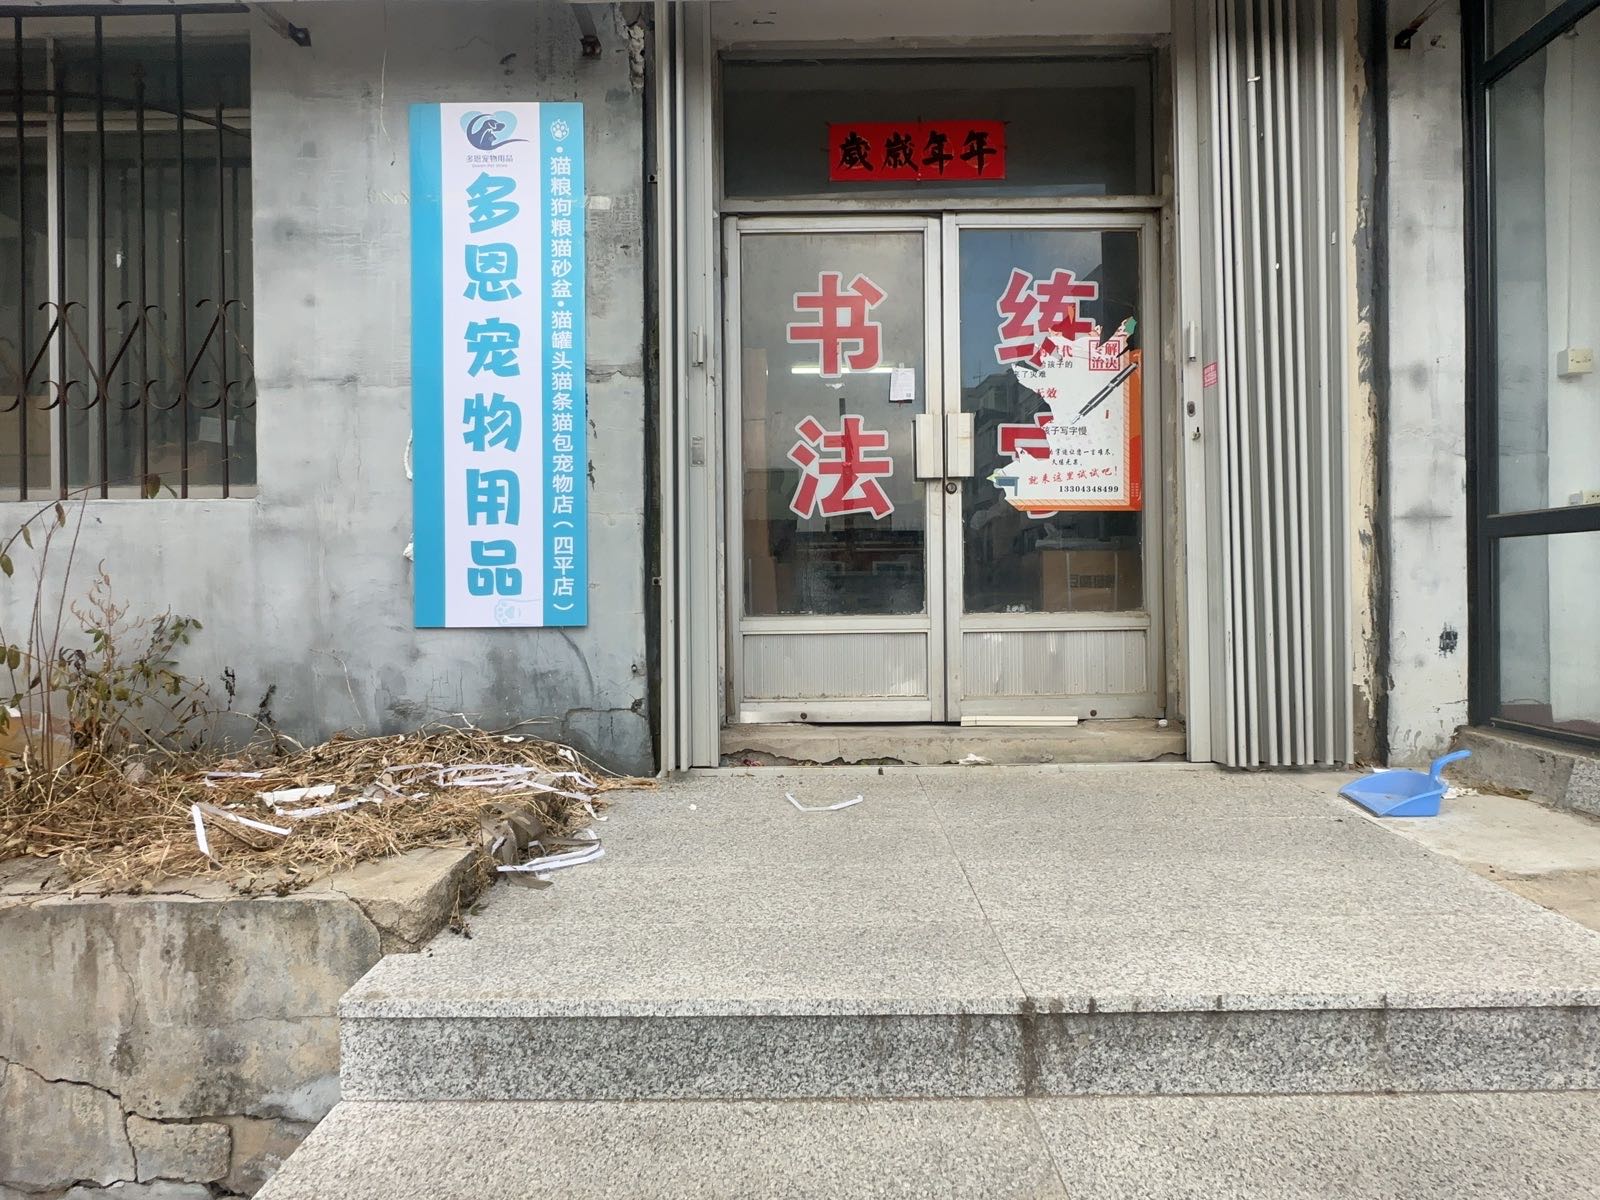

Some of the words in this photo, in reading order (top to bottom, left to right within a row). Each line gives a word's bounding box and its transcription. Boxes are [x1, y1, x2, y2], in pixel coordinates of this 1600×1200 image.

[462, 171, 523, 597] 多恩宠物用品
[787, 271, 895, 520] 书法
[1058, 485, 1119, 493] 13304348499
